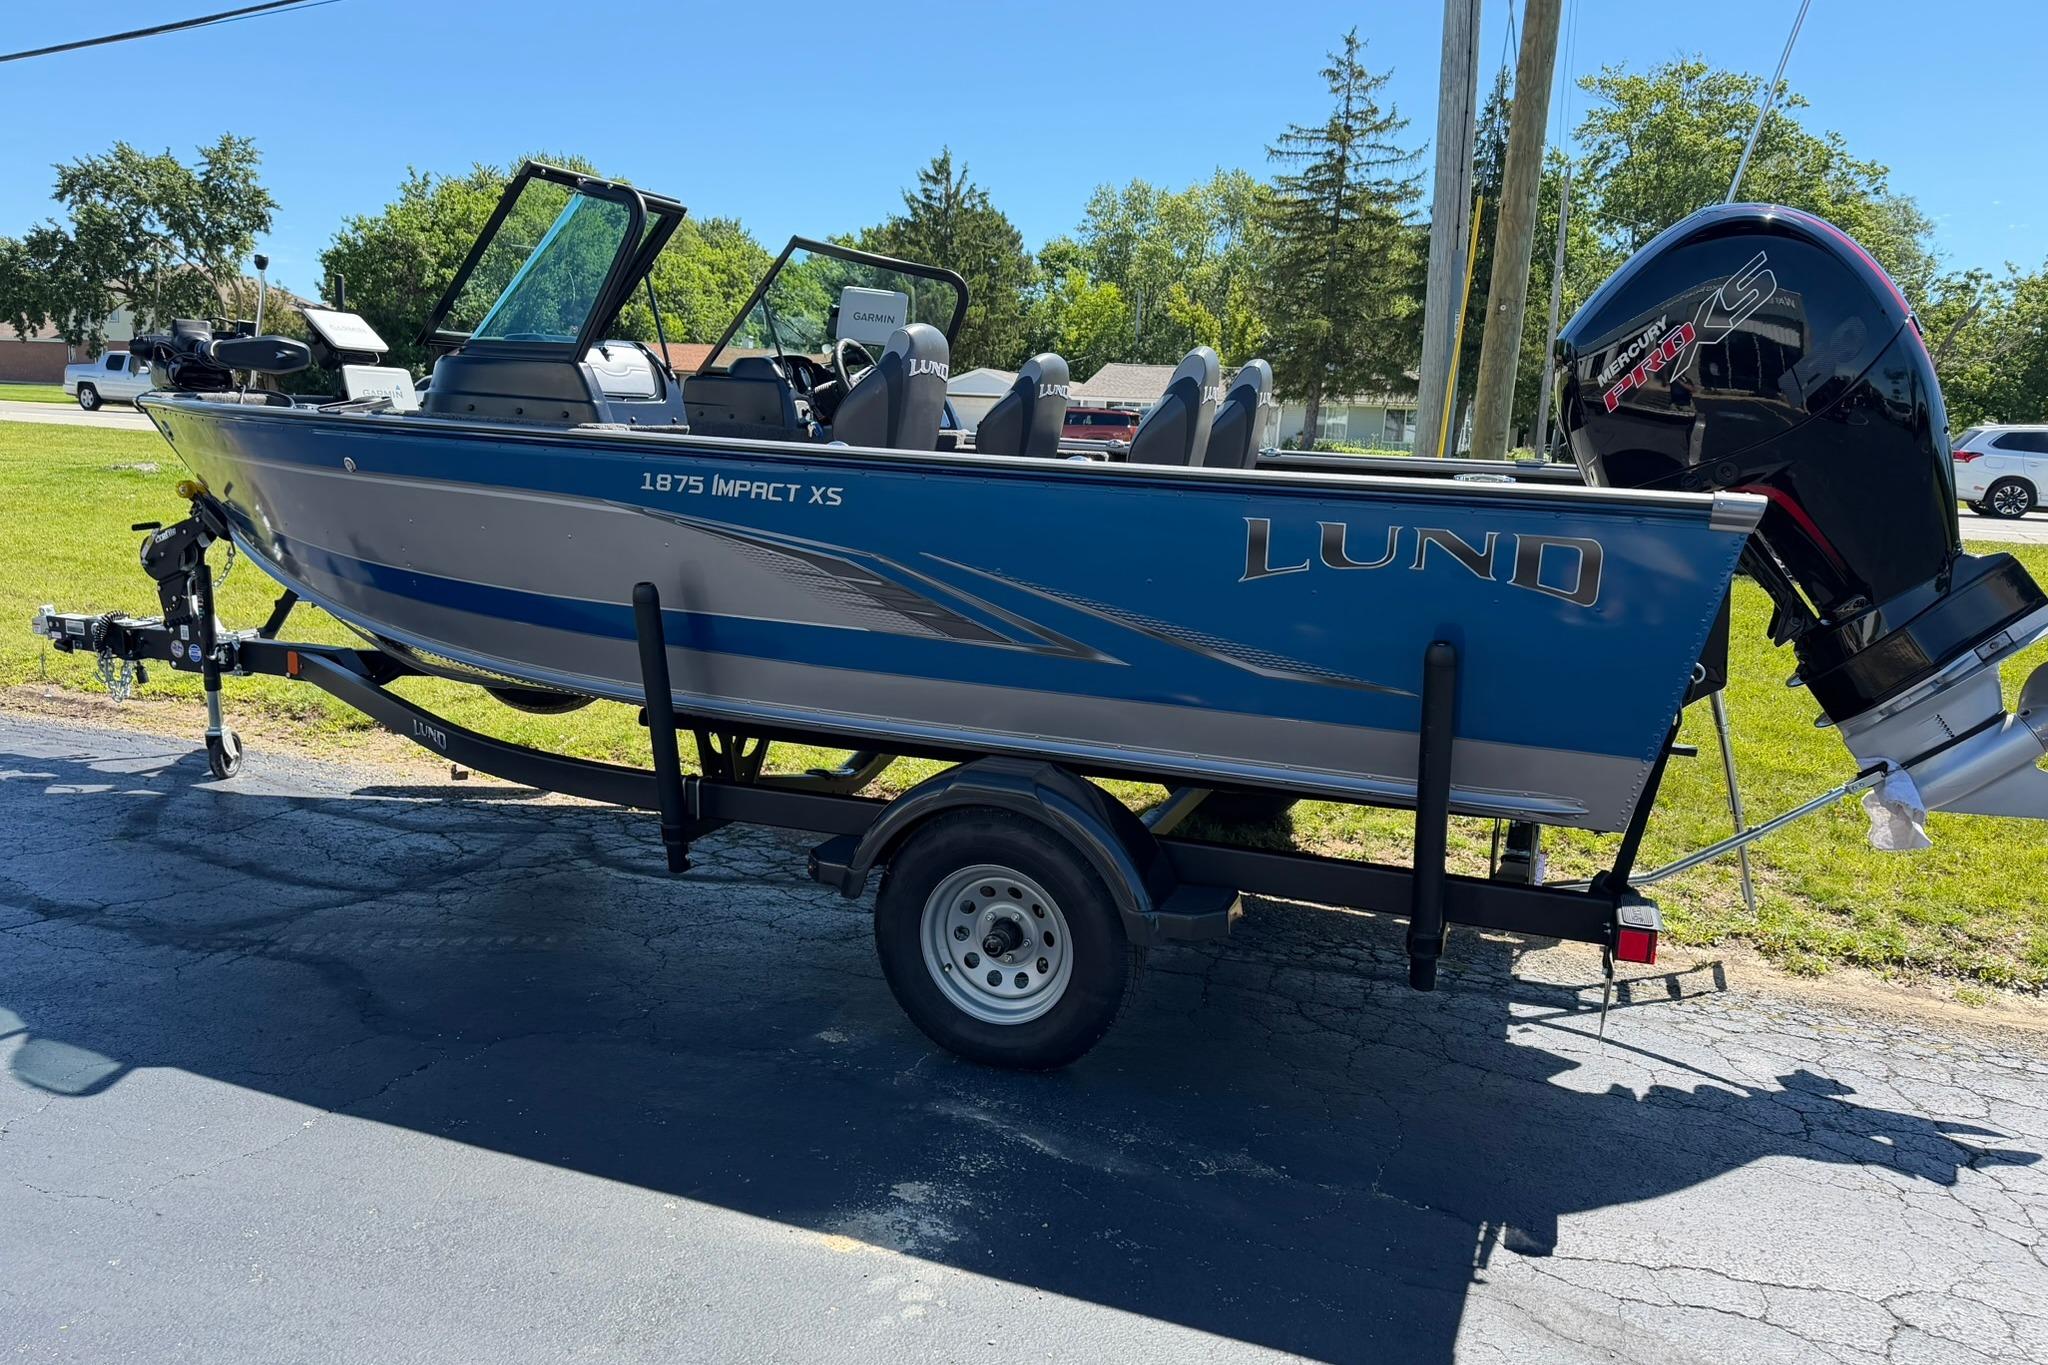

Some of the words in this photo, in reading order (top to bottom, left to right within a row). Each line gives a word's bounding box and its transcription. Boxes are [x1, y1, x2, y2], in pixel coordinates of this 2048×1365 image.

[853, 311, 895, 324] GARMIN
[1603, 321, 1696, 413] PRO
[1670, 250, 1777, 384] XS
[1597, 314, 1669, 388] MERCURY
[362, 389, 403, 399] GARMIN
[640, 472, 704, 494] 1875
[711, 473, 802, 502] IMPACT
[808, 485, 844, 506] XS
[1238, 517, 1603, 607] LUND
[413, 719, 447, 750] LUND
